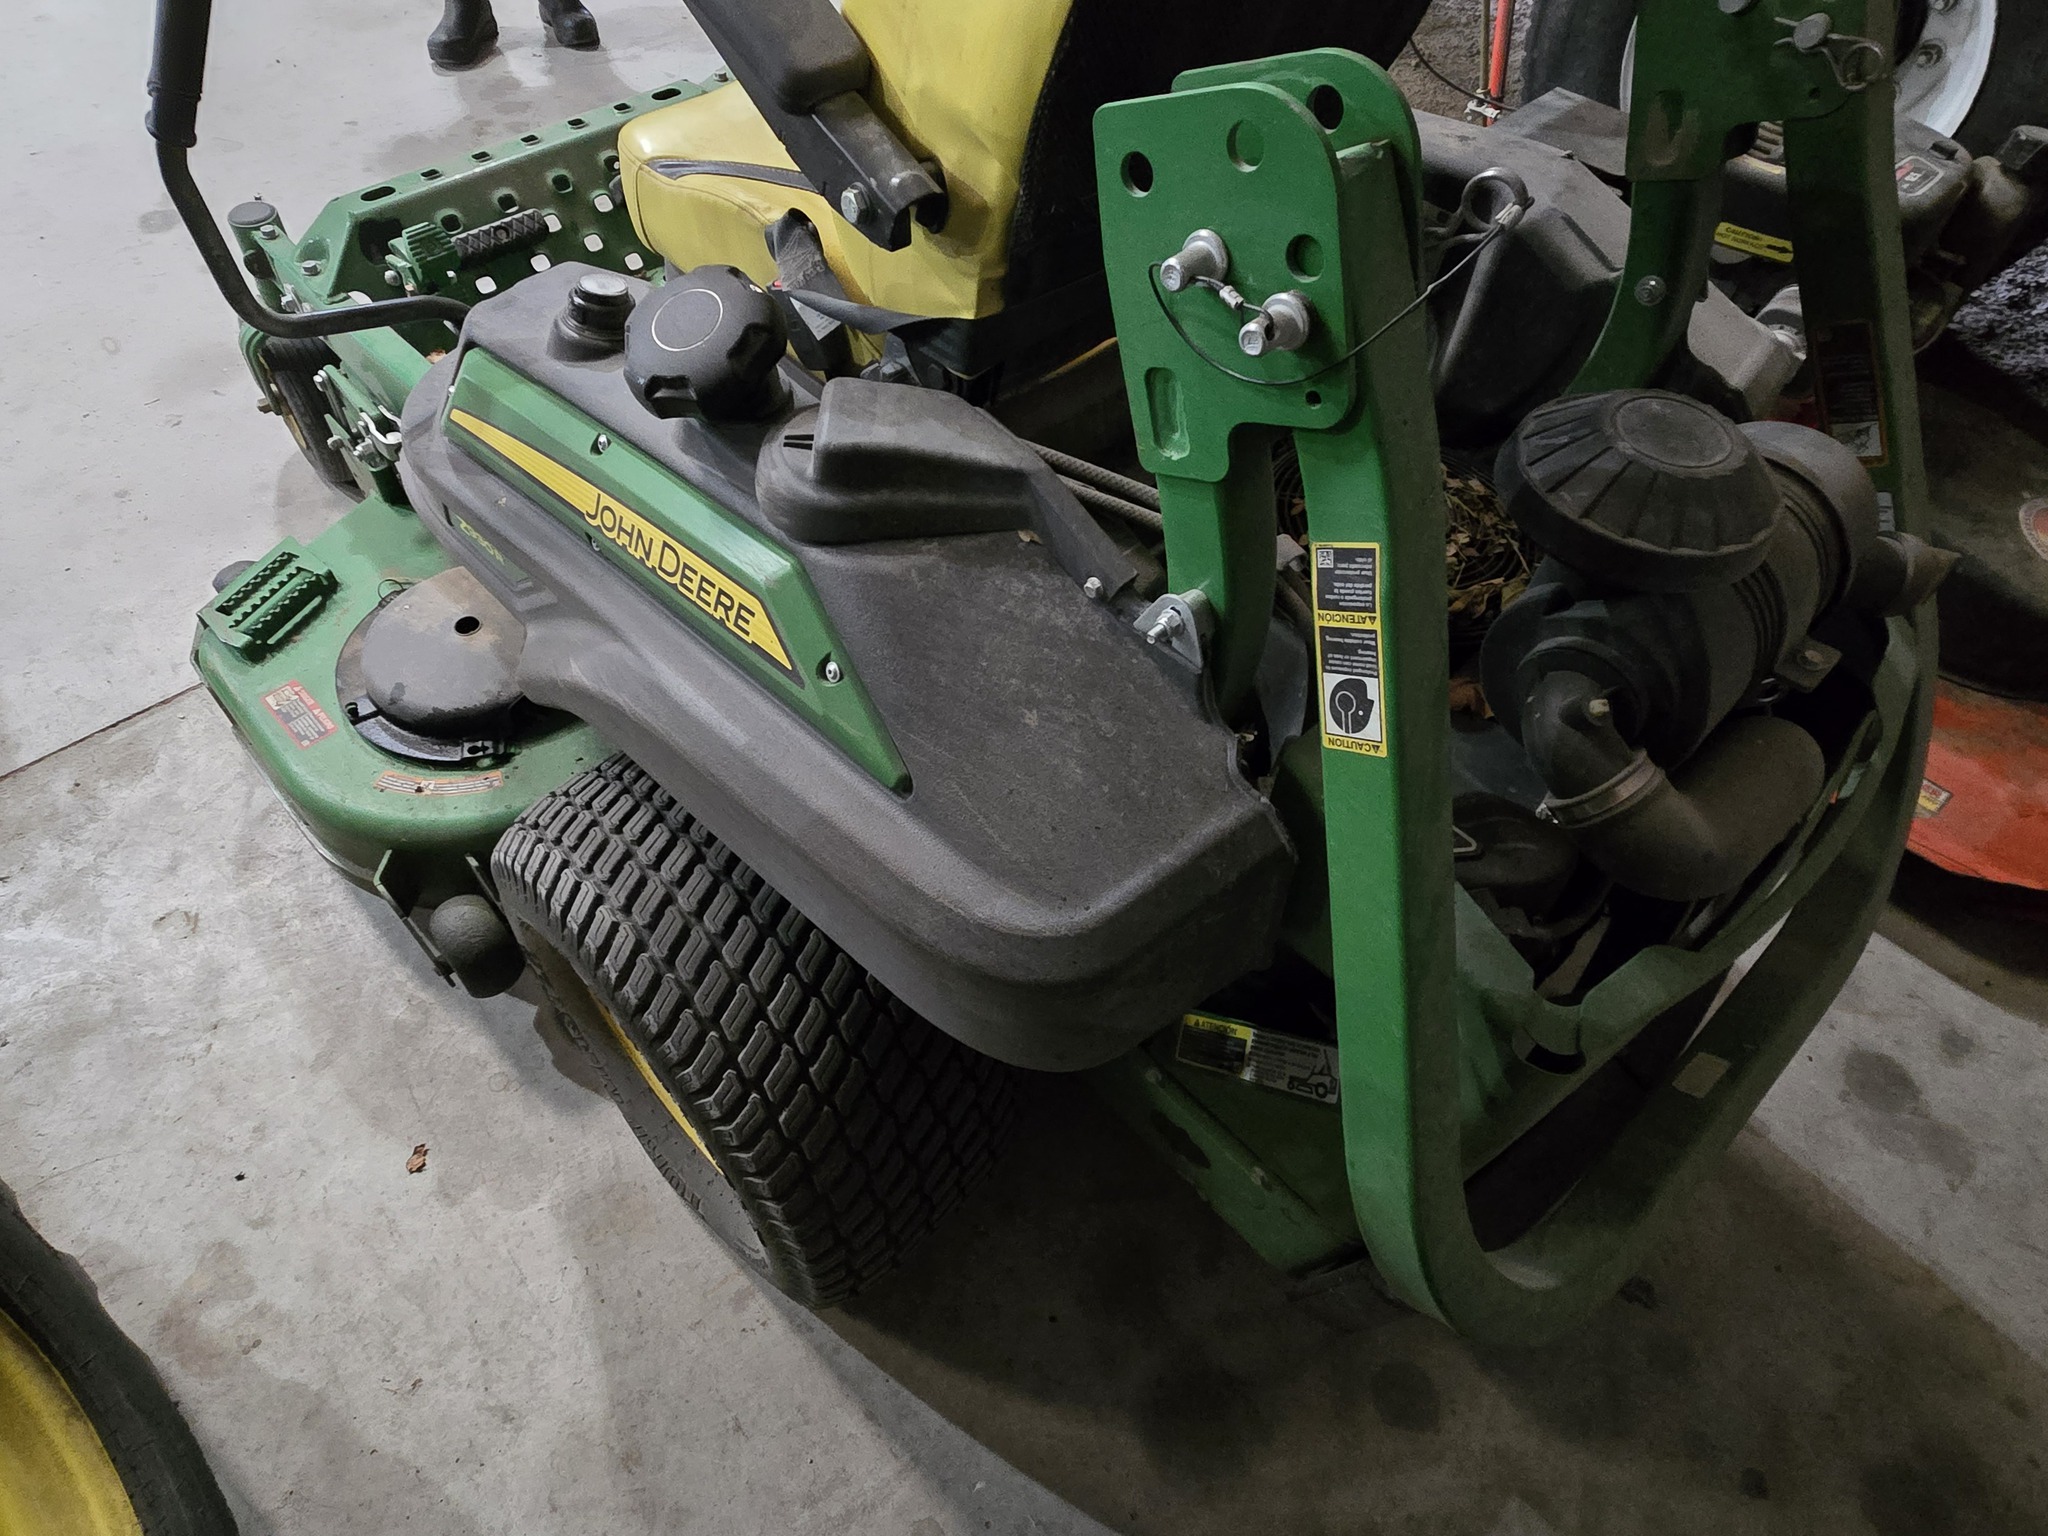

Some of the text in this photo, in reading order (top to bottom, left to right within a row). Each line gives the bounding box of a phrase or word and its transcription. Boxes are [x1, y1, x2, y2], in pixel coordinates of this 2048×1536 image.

[585, 493, 755, 637] JOHN DEERE
[1317, 612, 1367, 624] ATENCIÓN
[1328, 737, 1371, 752] CAUTION
